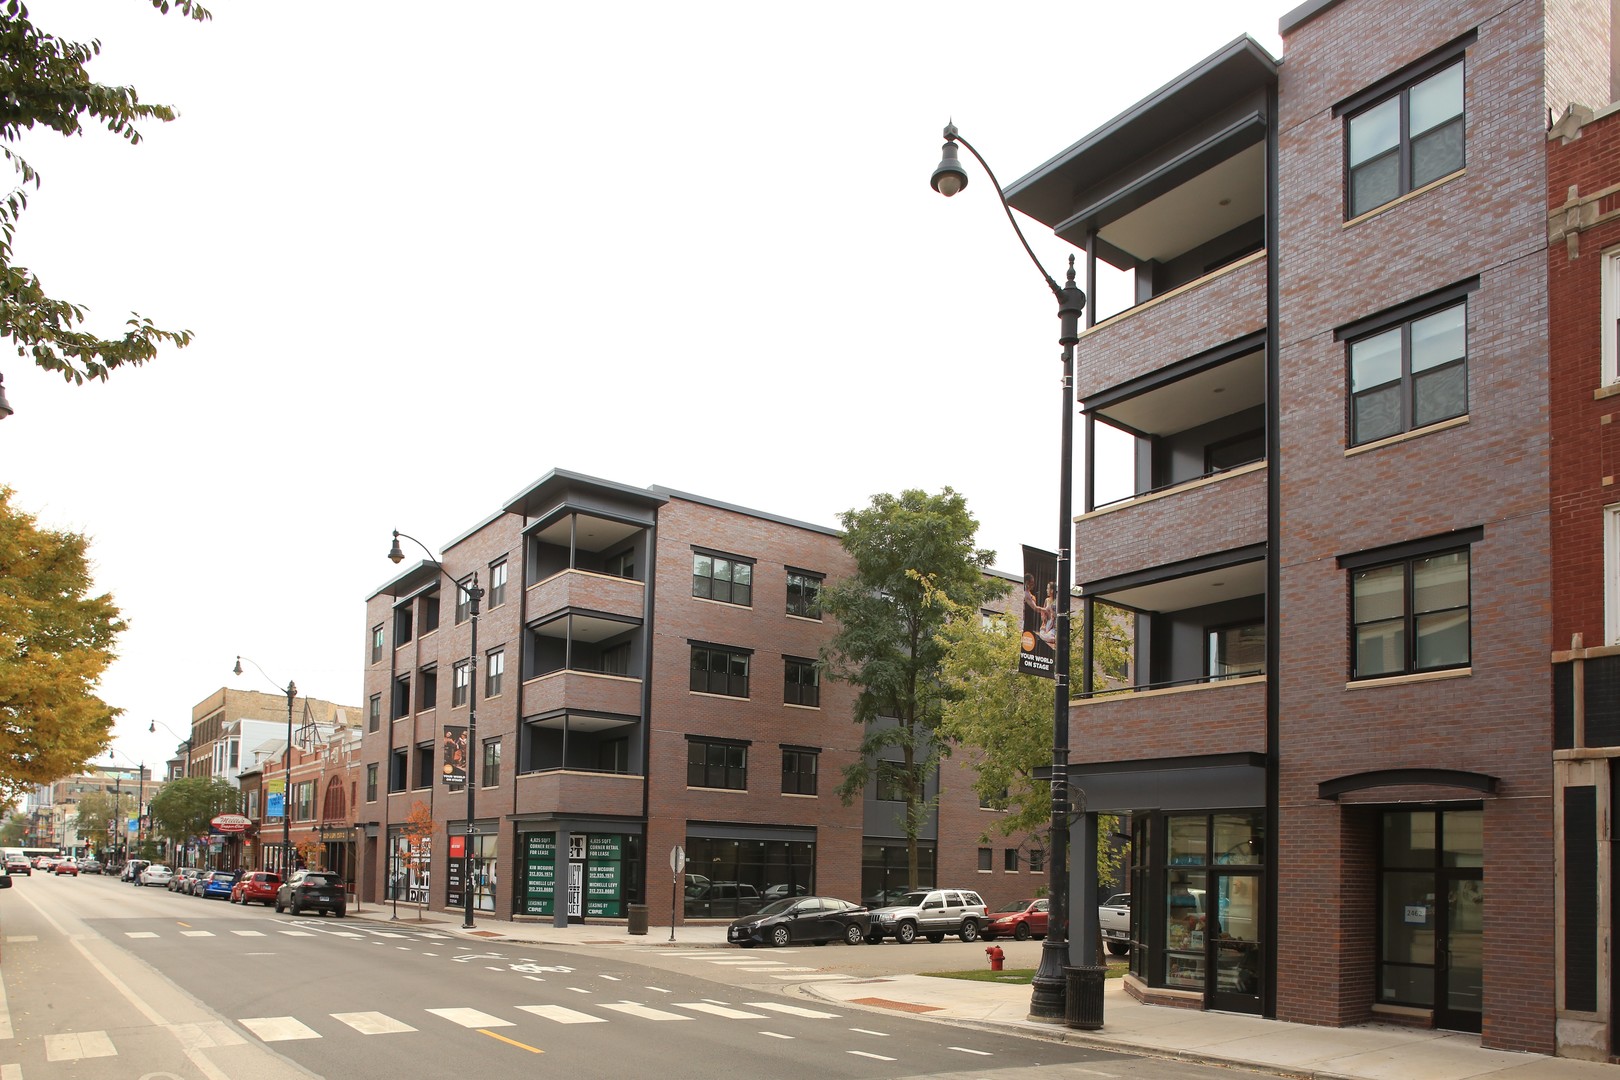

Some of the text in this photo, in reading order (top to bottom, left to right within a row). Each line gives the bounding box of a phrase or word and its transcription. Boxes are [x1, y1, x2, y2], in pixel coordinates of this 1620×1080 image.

[1035, 656, 1054, 664] WORLD
[1033, 662, 1050, 670] STAGE
[568, 891, 580, 904] UET
[568, 905, 579, 914] UET
